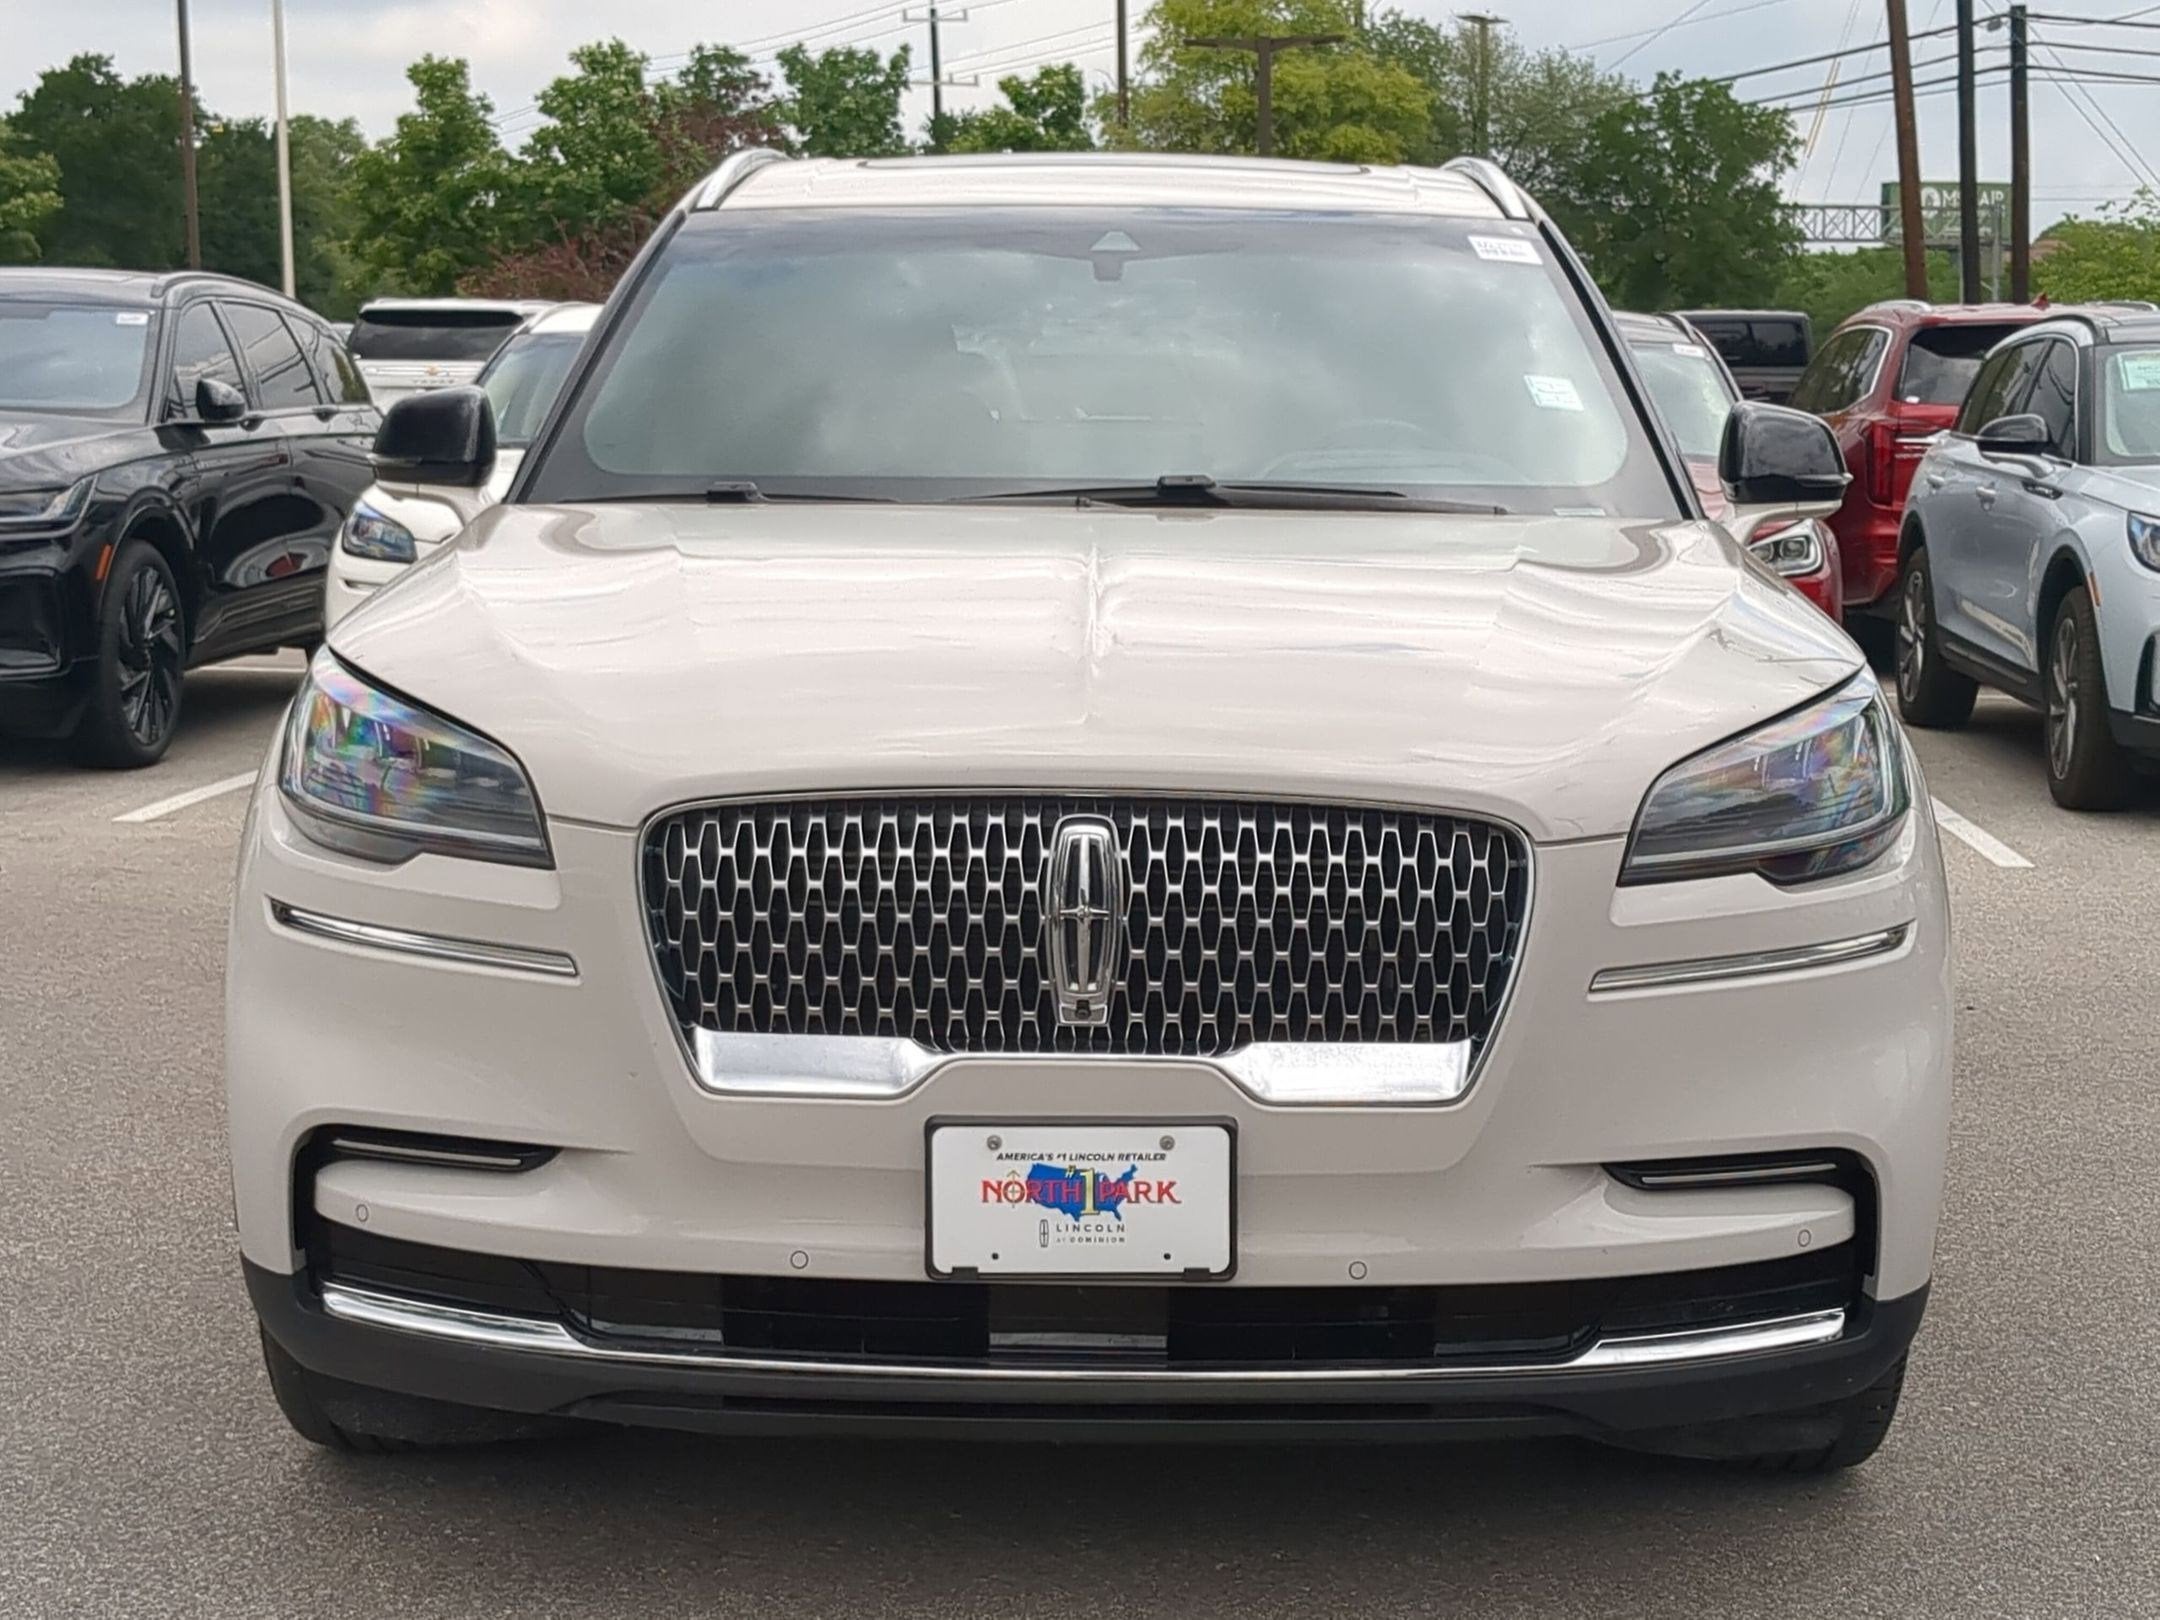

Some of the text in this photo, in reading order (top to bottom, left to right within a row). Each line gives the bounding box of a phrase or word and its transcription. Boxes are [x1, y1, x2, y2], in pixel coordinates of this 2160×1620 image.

[996, 1152, 1167, 1161] AMERICA'S #1 LINCOLN RETAILER
[982, 1180, 1182, 1204] NORTH PARK
[1056, 1223, 1126, 1233] LINCOLN
[1070, 1236, 1126, 1244] DOMINION
